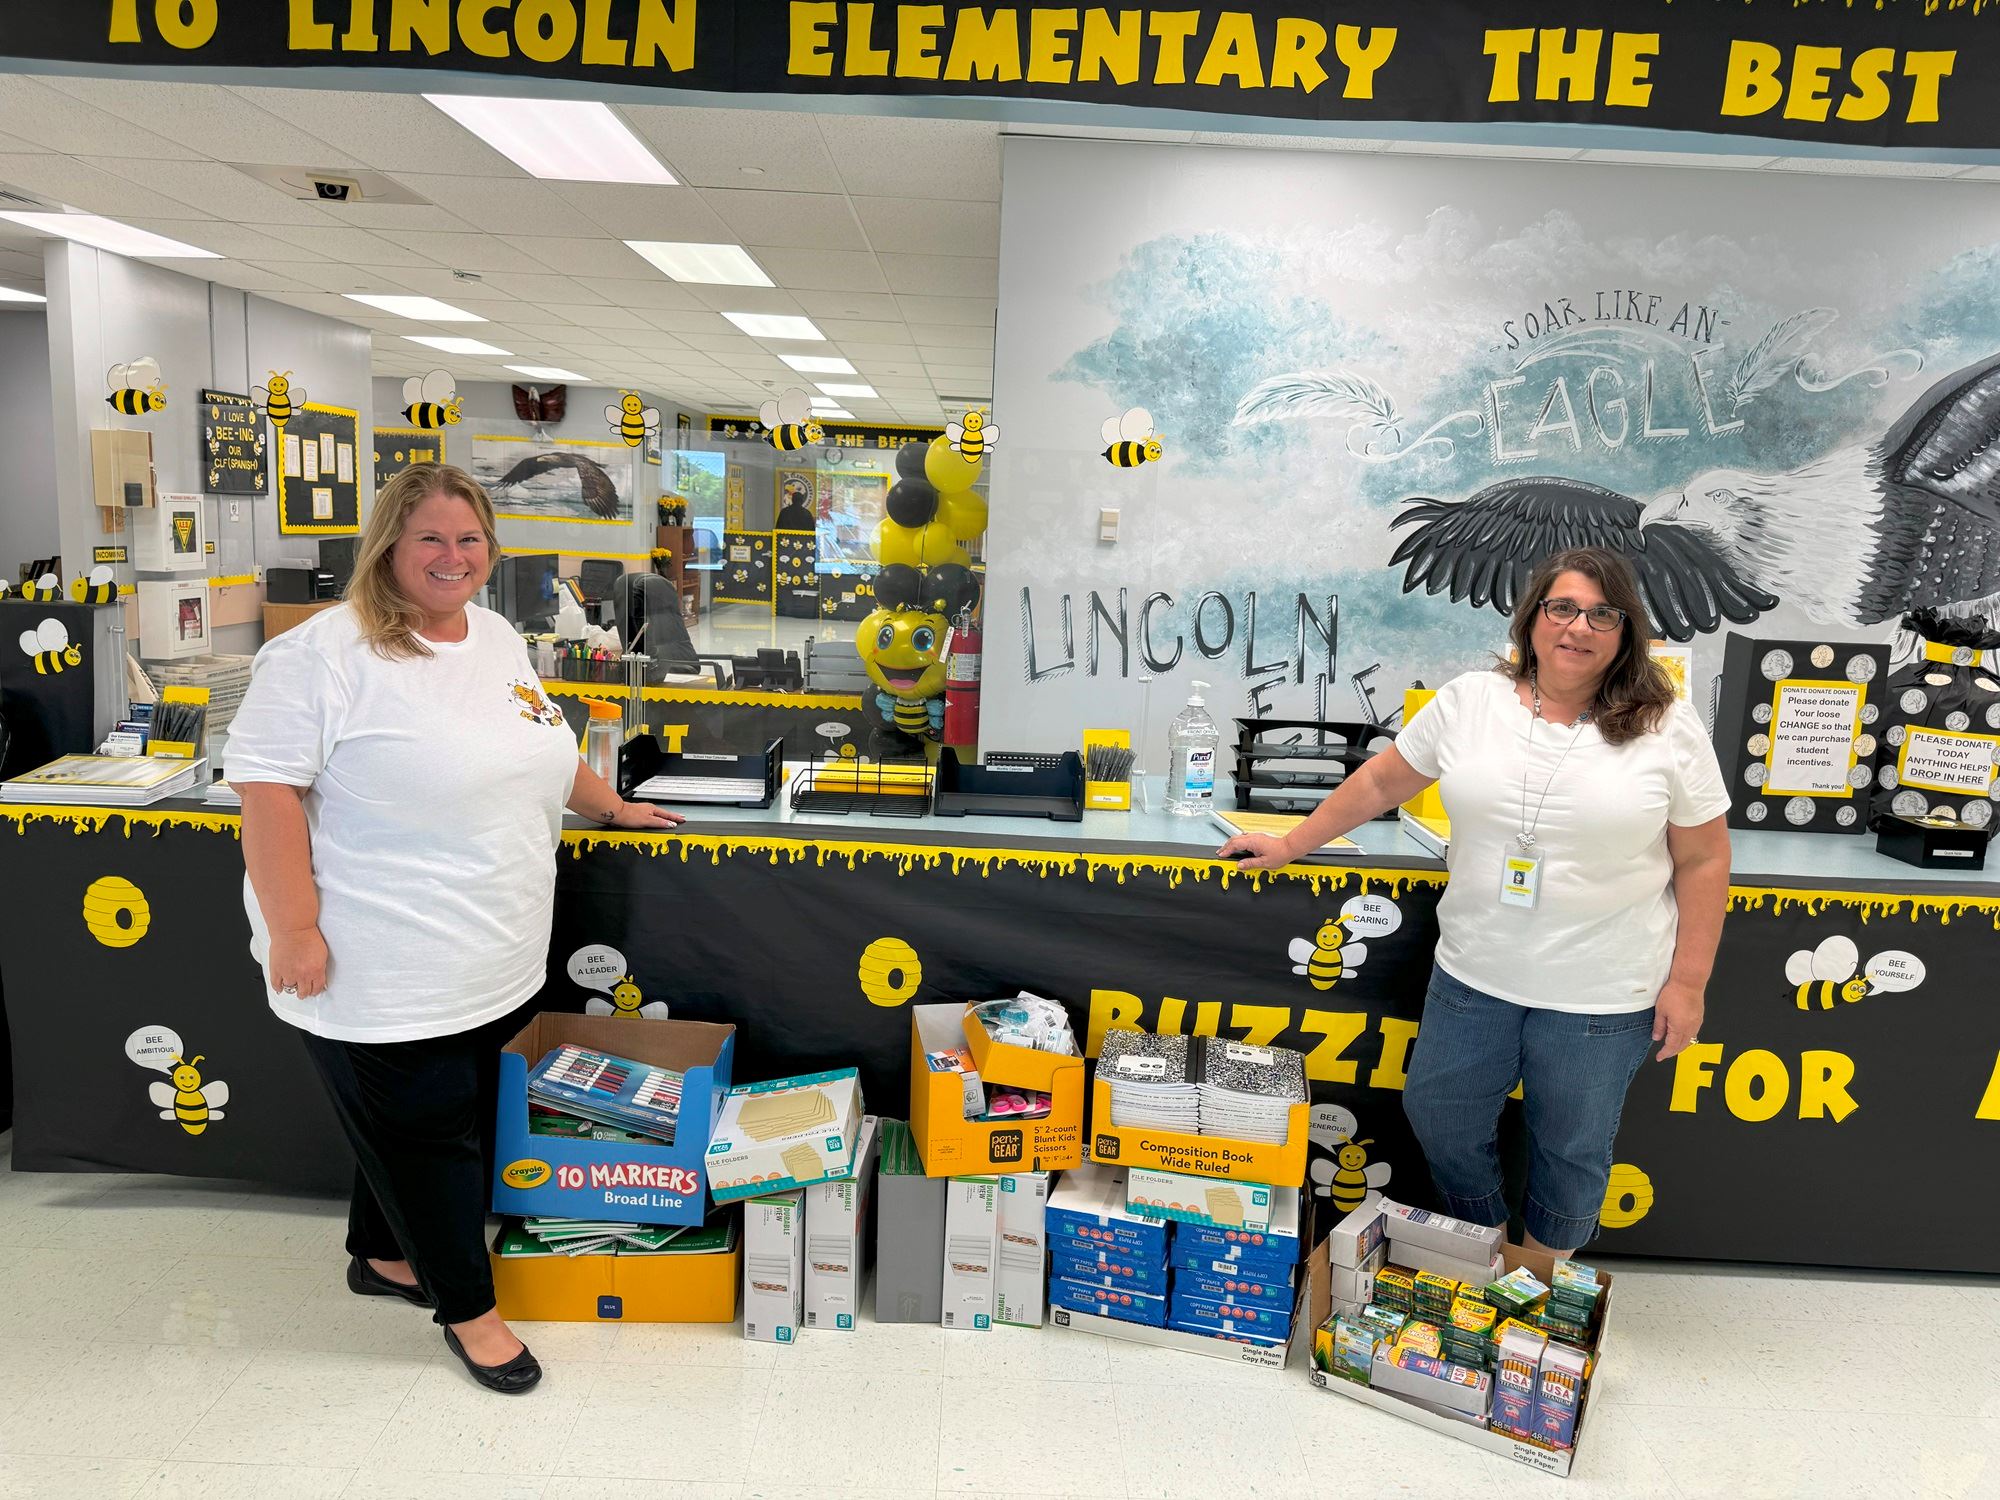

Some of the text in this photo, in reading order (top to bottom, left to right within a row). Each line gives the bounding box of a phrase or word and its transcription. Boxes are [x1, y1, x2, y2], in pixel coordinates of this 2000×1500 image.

[288, 0, 696, 72] LINCOLN
[787, 1, 1398, 101] ELEMENTARY
[1483, 28, 1662, 108] THE
[1720, 39, 1957, 124] BEST
[1595, 289, 1662, 326] LIKE
[1485, 344, 1745, 463] EAGLE
[228, 412, 245, 423] LOVE
[215, 426, 254, 442] BEE-ING
[835, 434, 865, 448] THE
[228, 445, 242, 456] OUR
[1020, 587, 1338, 685] LINCOLN
[1788, 696, 1850, 706] Please donate
[1794, 709, 1840, 718] Your loose
[1780, 721, 1819, 730] CHANGE
[1835, 723, 1851, 731] that
[1810, 735, 1851, 743] purchase
[1914, 734, 1992, 749] PLEASE DONATE
[1796, 746, 1829, 754] student
[1936, 749, 1969, 759] TODAY
[1787, 758, 1833, 767] incentives.
[1907, 756, 1957, 769] ANYTHING
[1910, 768, 1984, 784] DROP IN HERE
[1363, 904, 1381, 912] BEE
[1353, 915, 1389, 925] CARING
[587, 955, 605, 963] BEE
[1888, 959, 1906, 968] BEE
[585, 966, 617, 975] LEADER
[1875, 969, 1914, 981] YOURSELF
[145, 1036, 163, 1044] BEE
[136, 1047, 174, 1055] AMBITIOUS
[1669, 1043, 1860, 1123] FOR
[1320, 1113, 1338, 1122] BEE
[592, 1130, 602, 1140] 10
[1046, 1125, 1077, 1133] 2-count
[1034, 1133, 1076, 1143] Blunt Kids
[994, 1144, 1018, 1158] GEAR
[1034, 1144, 1067, 1153] Scissors
[1099, 1144, 1117, 1156] GEAR
[1140, 1140, 1254, 1163] Composition Book
[707, 1155, 749, 1167] FILE FOLDERS
[1160, 1155, 1230, 1174] Wide Ruled
[510, 1165, 545, 1176] Crayola
[558, 1164, 698, 1194] 10 MARKERS
[1146, 1177, 1173, 1185] FOLDERS
[604, 1191, 683, 1208] Broad Line
[783, 1208, 791, 1236] DURABLE
[1242, 1346, 1281, 1359] Single Ream
[1241, 1354, 1278, 1366] Copy Paper
[1503, 1370, 1528, 1387] USA
[1500, 1381, 1529, 1394] TITANIUM
[1545, 1382, 1570, 1399] USA
[1541, 1392, 1571, 1407] TITANIUM
[1492, 1420, 1503, 1429] 48
[1531, 1432, 1543, 1441] 48
[1513, 1444, 1559, 1463] Single Ream
[1513, 1451, 1555, 1471] Copy Paper
